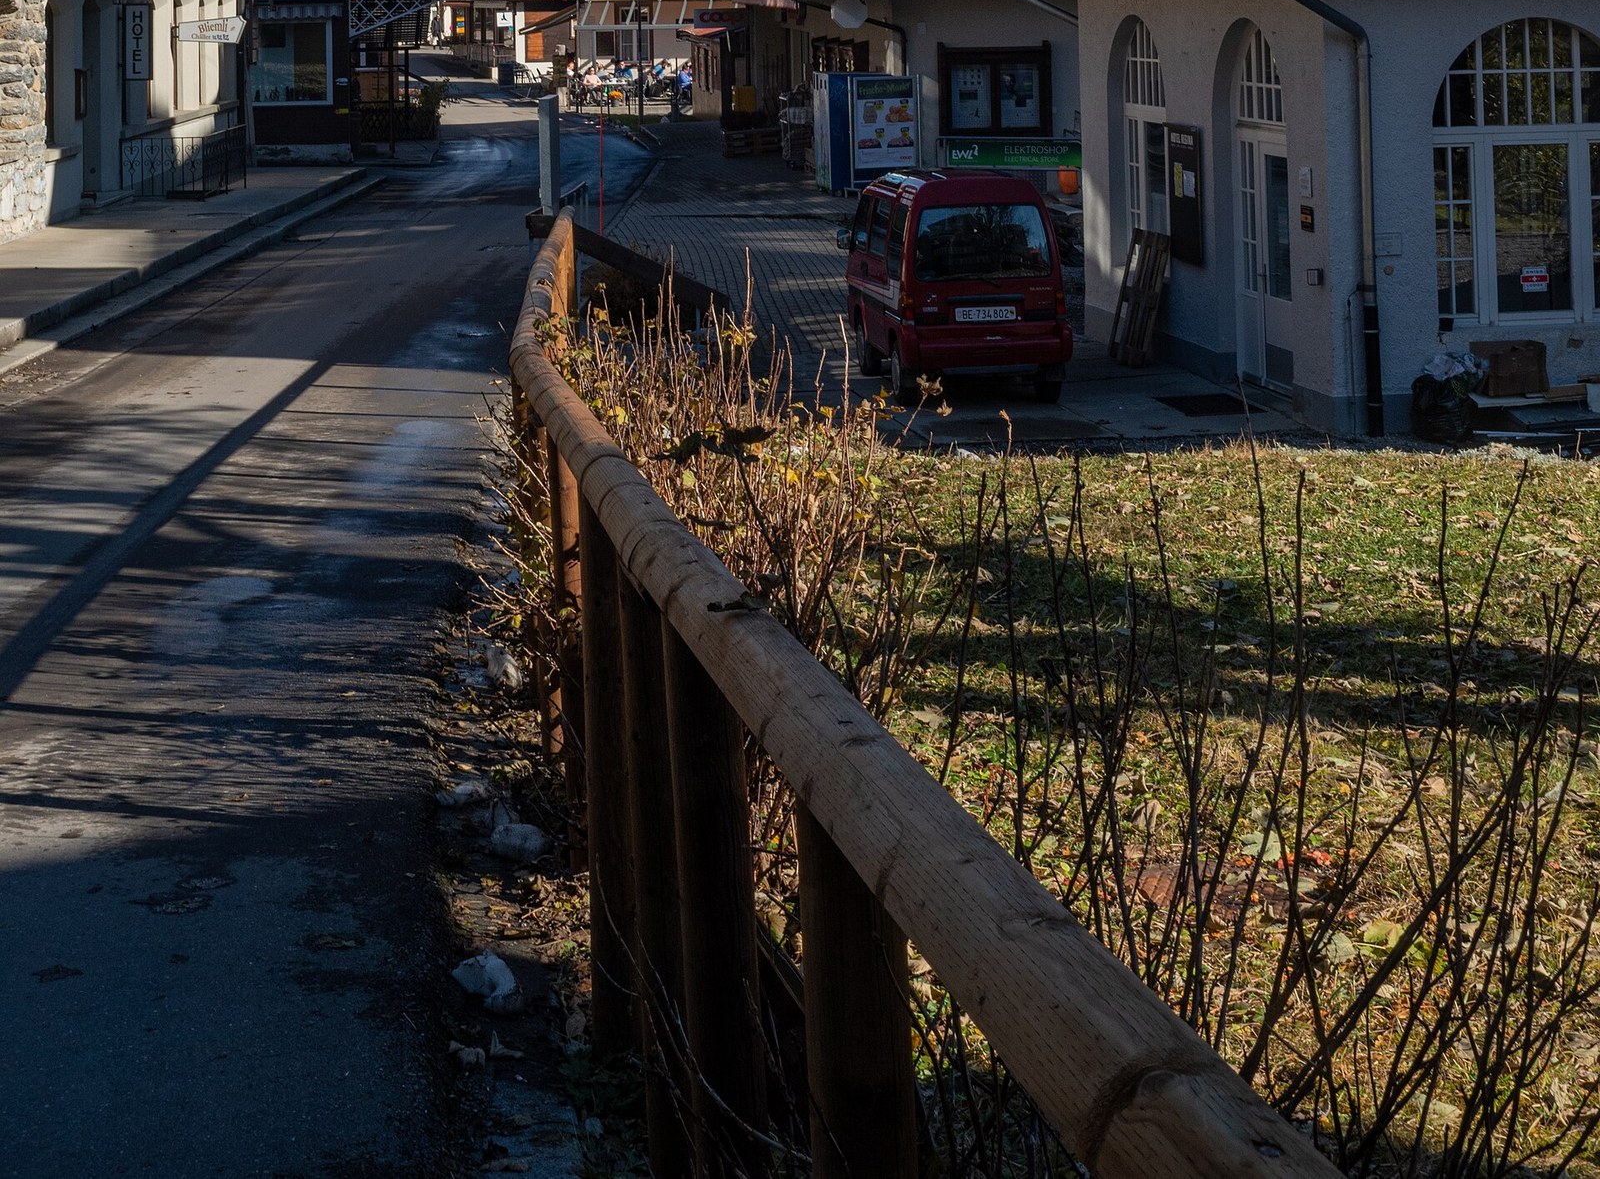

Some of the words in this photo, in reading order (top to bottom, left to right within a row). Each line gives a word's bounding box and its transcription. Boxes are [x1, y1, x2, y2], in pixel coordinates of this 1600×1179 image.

[198, 18, 228, 34] Bliemli
[132, 10, 144, 75] HOTEL
[1004, 145, 1069, 154] ELEKTROSHOP
[1004, 155, 1039, 163] ELECTRICAL
